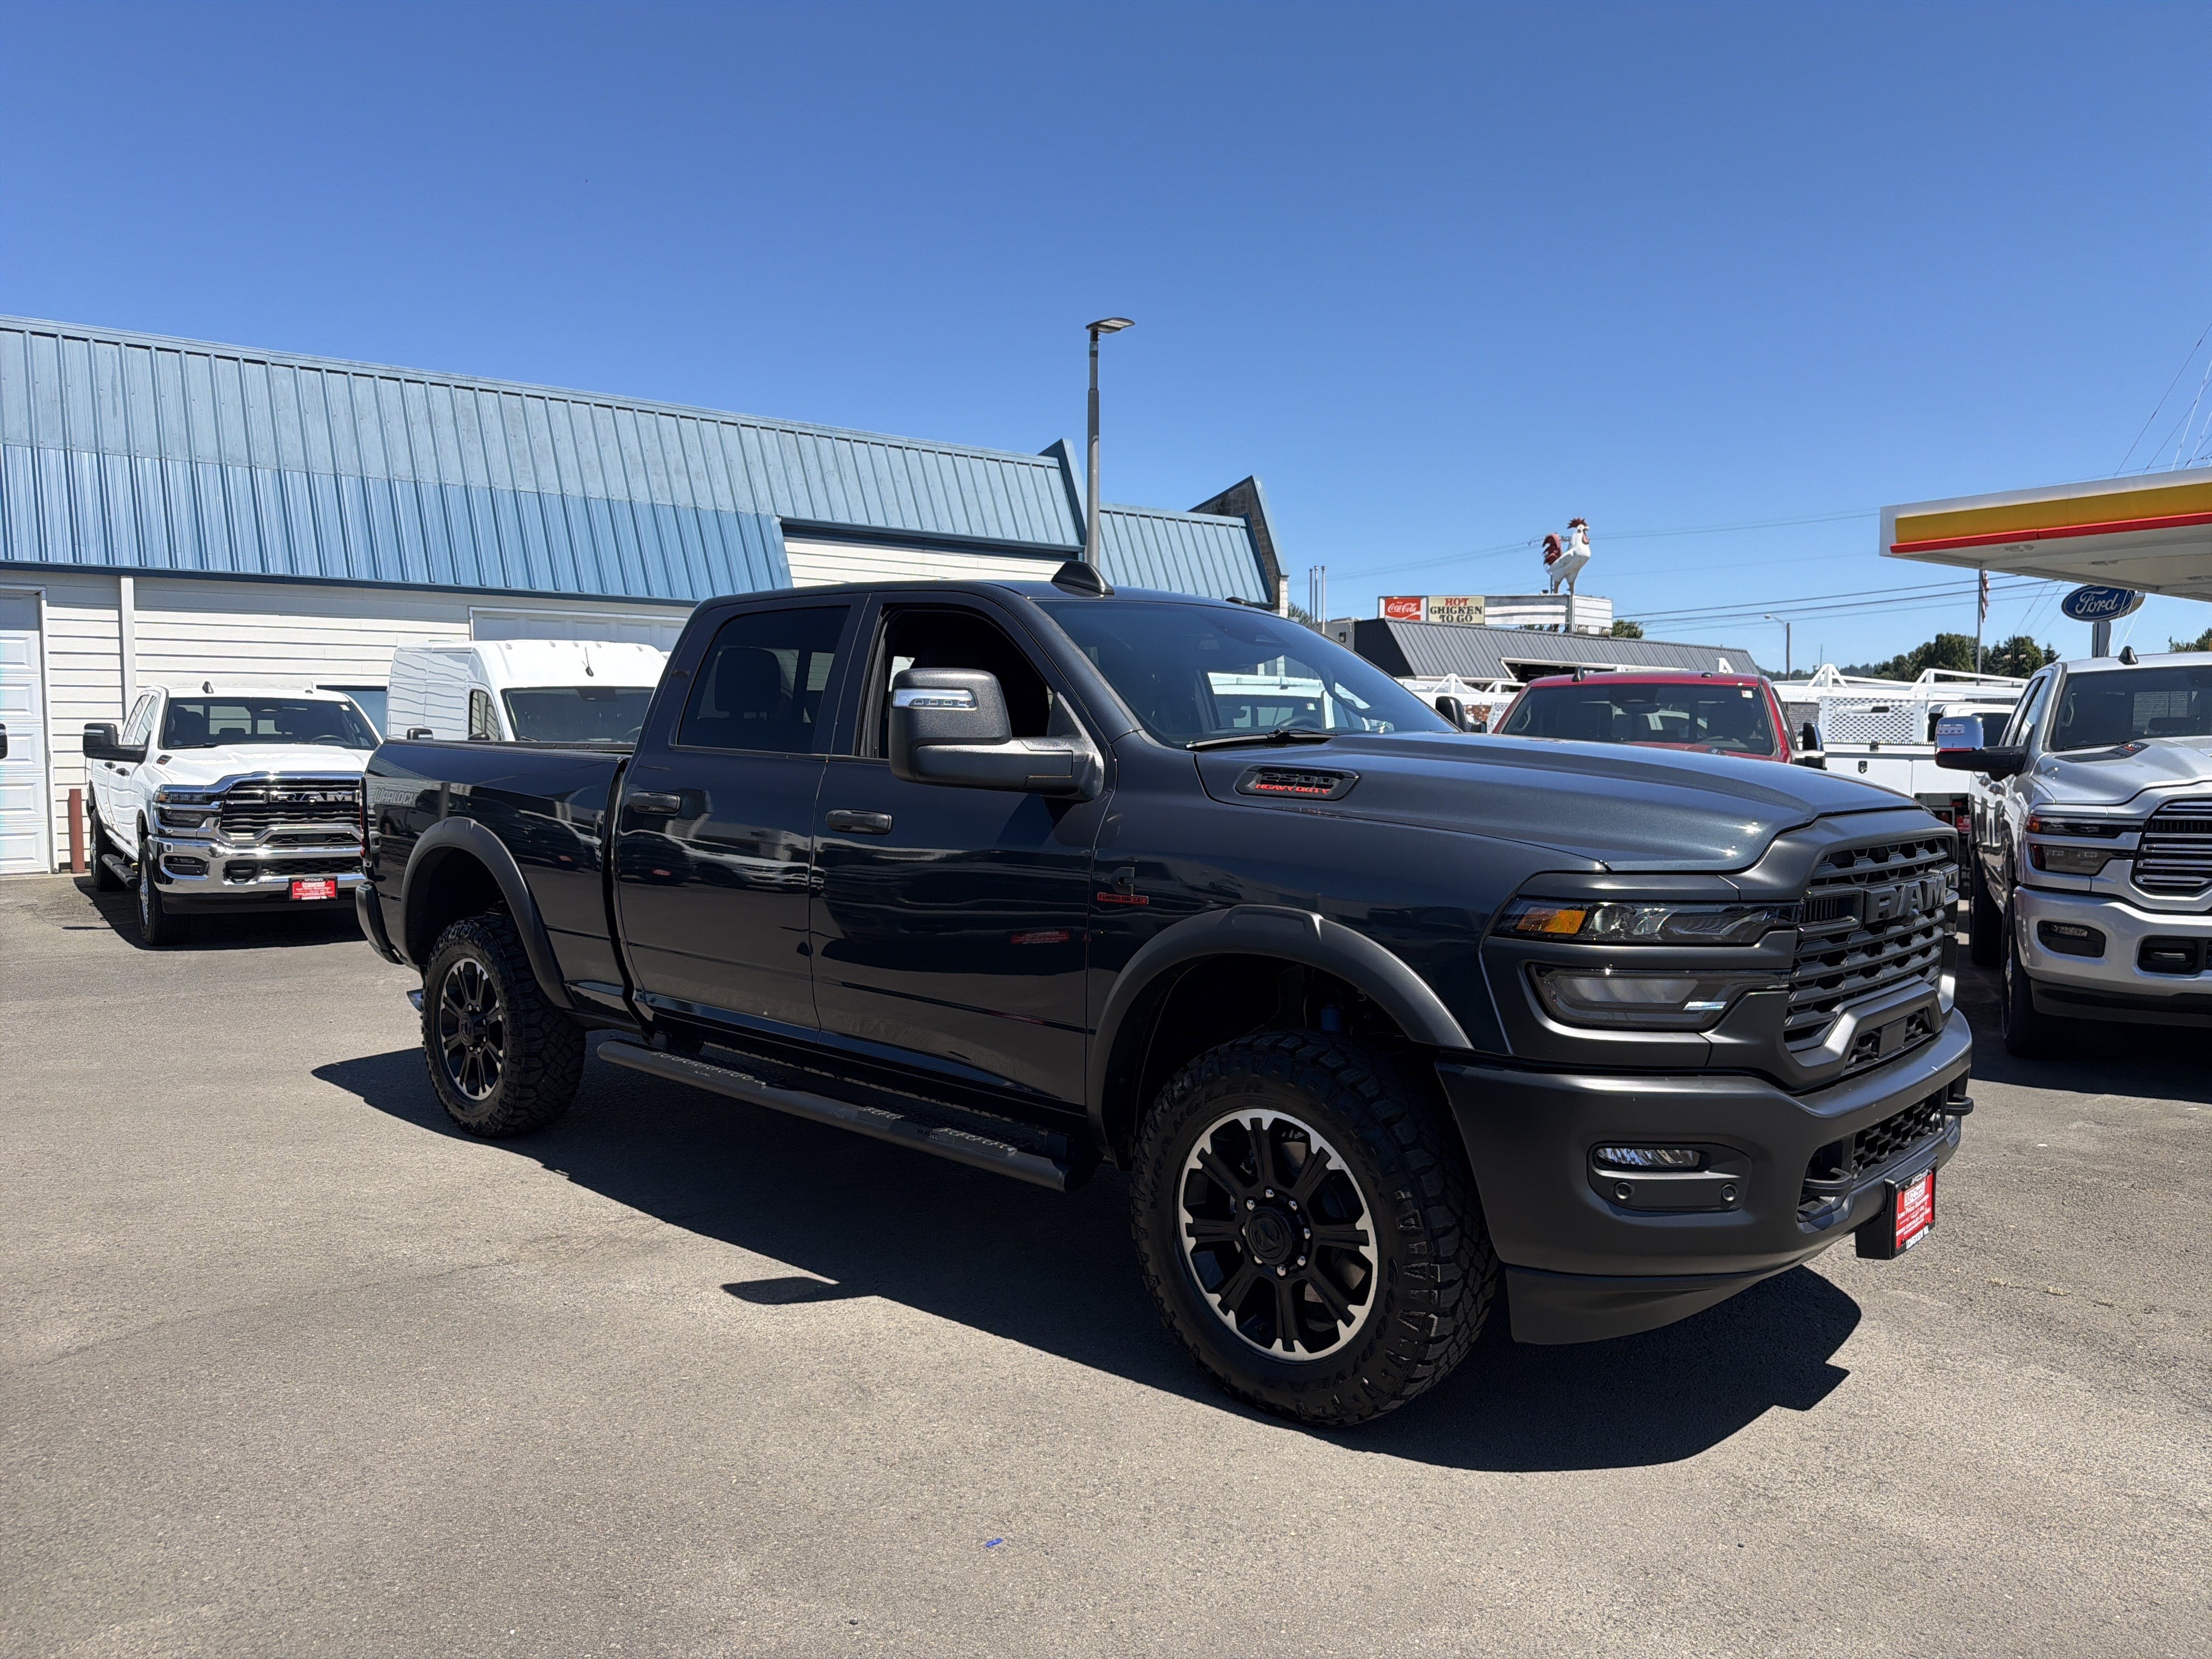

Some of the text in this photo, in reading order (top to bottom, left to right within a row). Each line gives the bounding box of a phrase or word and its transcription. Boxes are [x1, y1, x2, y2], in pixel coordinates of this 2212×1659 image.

[1444, 597, 1469, 606] HOT
[2075, 589, 2119, 614] Ford
[1430, 606, 1482, 614] CHICKEN
[1439, 614, 1473, 623] TO GO
[1261, 772, 1335, 786] 2500
[1255, 783, 1331, 794] HEAVY DUTY
[270, 791, 353, 802] RAM
[1866, 874, 1945, 924] RAM
